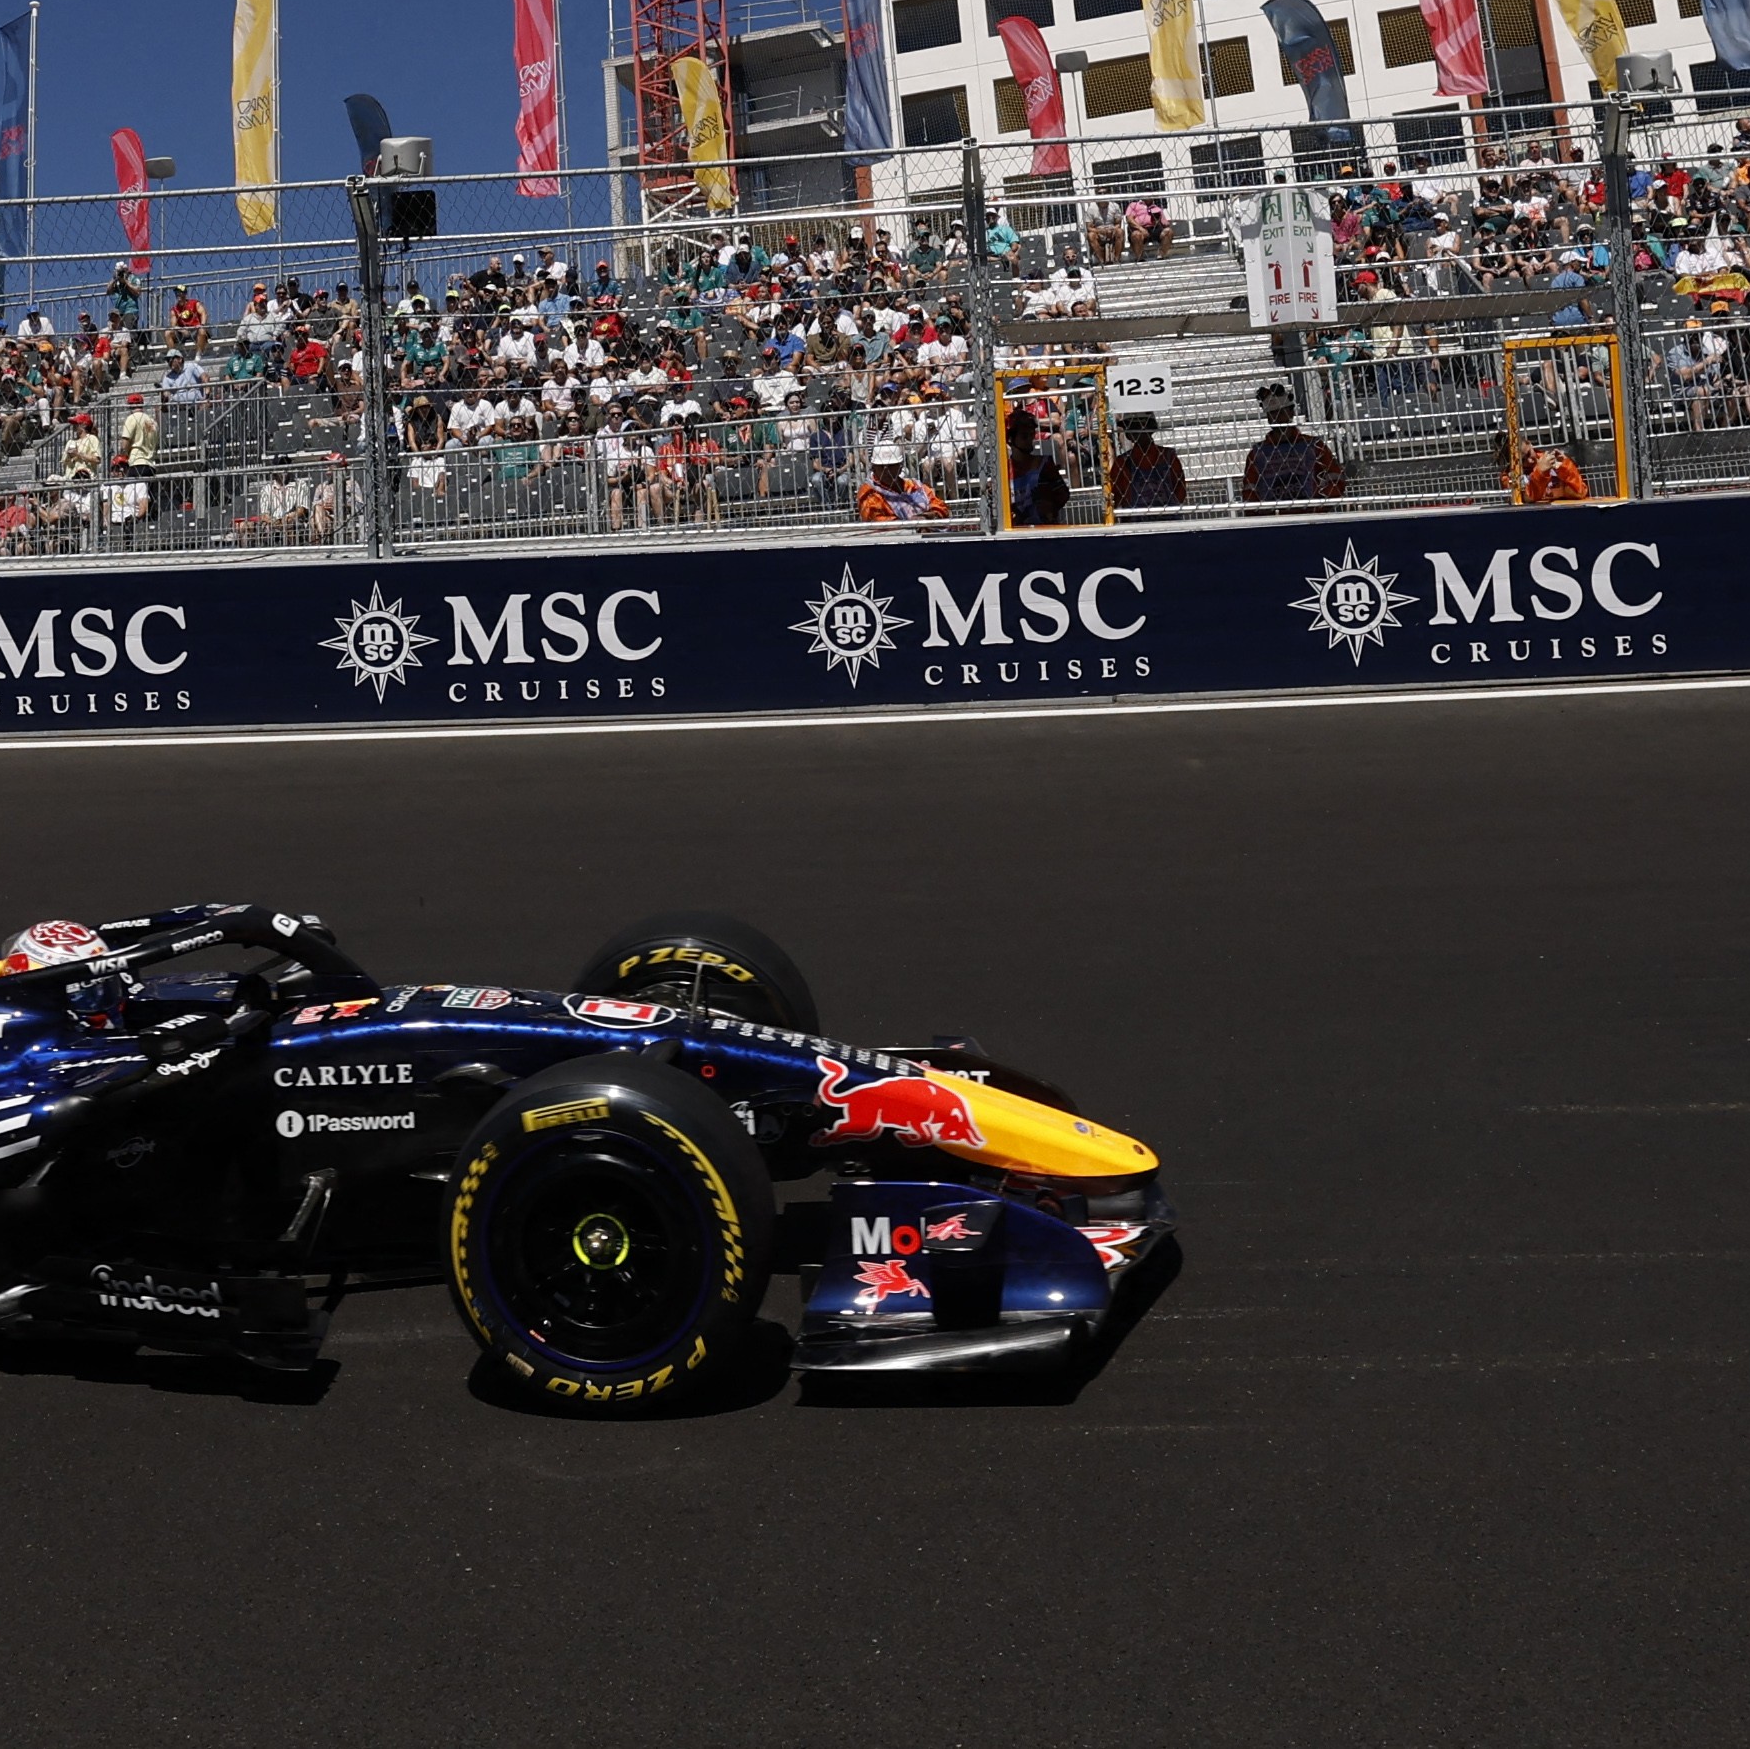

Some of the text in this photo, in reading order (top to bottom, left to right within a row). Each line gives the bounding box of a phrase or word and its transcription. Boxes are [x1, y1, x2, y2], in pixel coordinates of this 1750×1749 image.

[1262, 226, 1285, 241] EXIT
[1293, 225, 1313, 237] EXIT
[1269, 292, 1291, 306] FIRE
[1298, 291, 1319, 303] FIRE
[1113, 376, 1166, 397] 12.3
[1424, 542, 1663, 625] MSC
[918, 567, 1147, 647] MSC
[444, 590, 663, 665] MSC
[1431, 634, 1667, 663] CRUISES
[925, 657, 1150, 685] CRUISES
[449, 678, 666, 702] CRUISES
[171, 931, 224, 954] PRYPCO
[85, 956, 129, 975] VISA
[619, 947, 755, 982] P ZERO
[273, 1064, 413, 1087] CARLYLE
[306, 1111, 415, 1132] 1Password
[521, 1097, 610, 1133] PIRELLI
[545, 1335, 707, 1401] P ZERO
